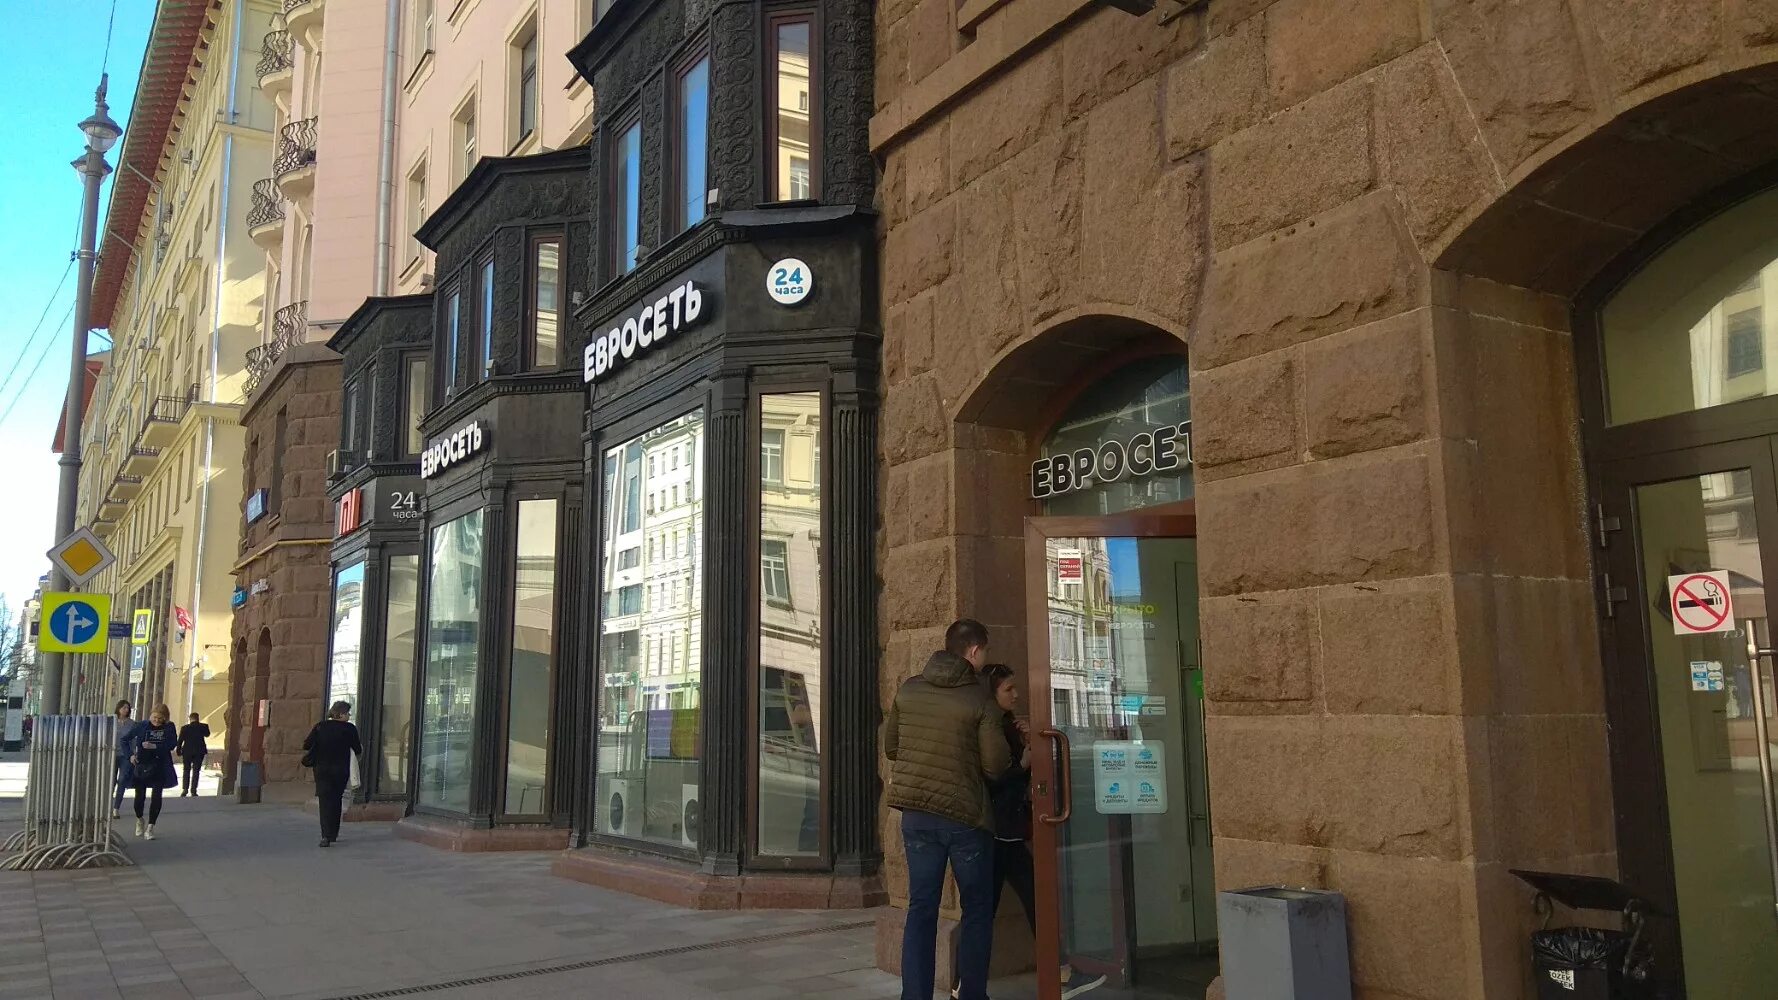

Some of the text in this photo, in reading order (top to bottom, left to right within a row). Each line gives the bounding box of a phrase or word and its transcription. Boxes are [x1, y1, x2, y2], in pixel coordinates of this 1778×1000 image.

[775, 267, 803, 285] 24
[775, 286, 804, 295] часа
[584, 280, 702, 383] ЕВРОСЕТЬ
[421, 420, 482, 479] ЕВРОСЕТЬ
[1032, 420, 1193, 498] ЕВРОСЕТ
[390, 491, 416, 509] 24
[392, 510, 418, 519] часа
